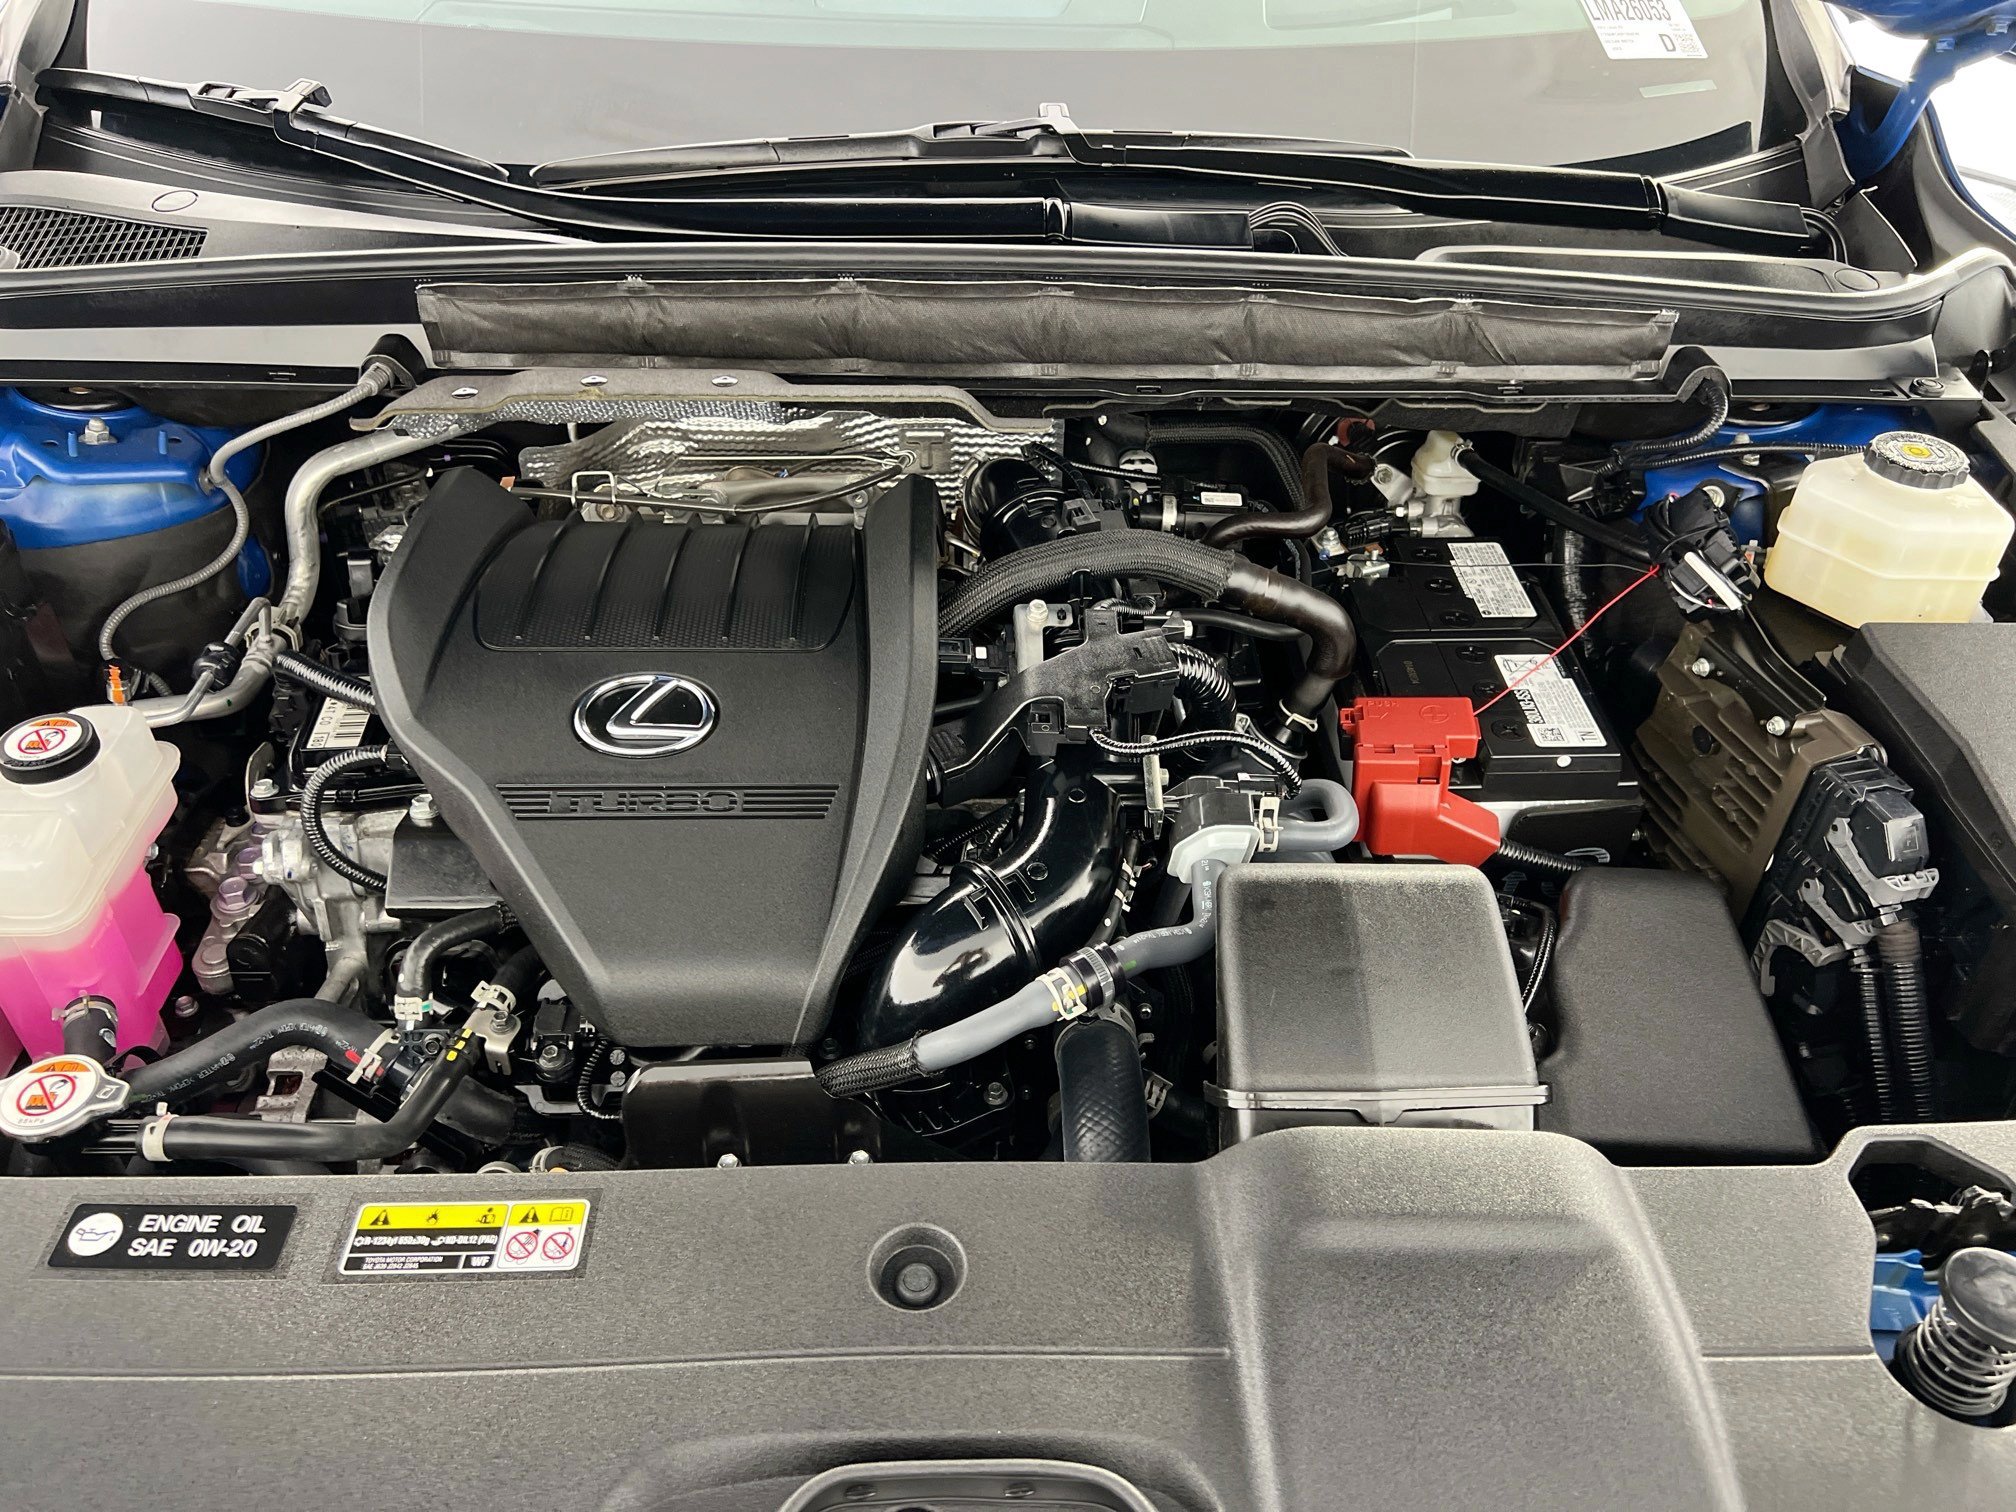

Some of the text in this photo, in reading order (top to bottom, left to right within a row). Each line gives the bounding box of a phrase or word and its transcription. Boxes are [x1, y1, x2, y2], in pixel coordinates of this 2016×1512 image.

[1587, 0, 1672, 21] LMA26053
[1658, 33, 1676, 52] D
[556, 791, 738, 813] TURBO
[138, 1214, 267, 1233] ENGINE OIL
[127, 1238, 258, 1258] SAE 0W-20
[478, 1234, 498, 1246] (PAG)
[364, 1256, 387, 1264] TOYOTA
[471, 1256, 491, 1267] WF
